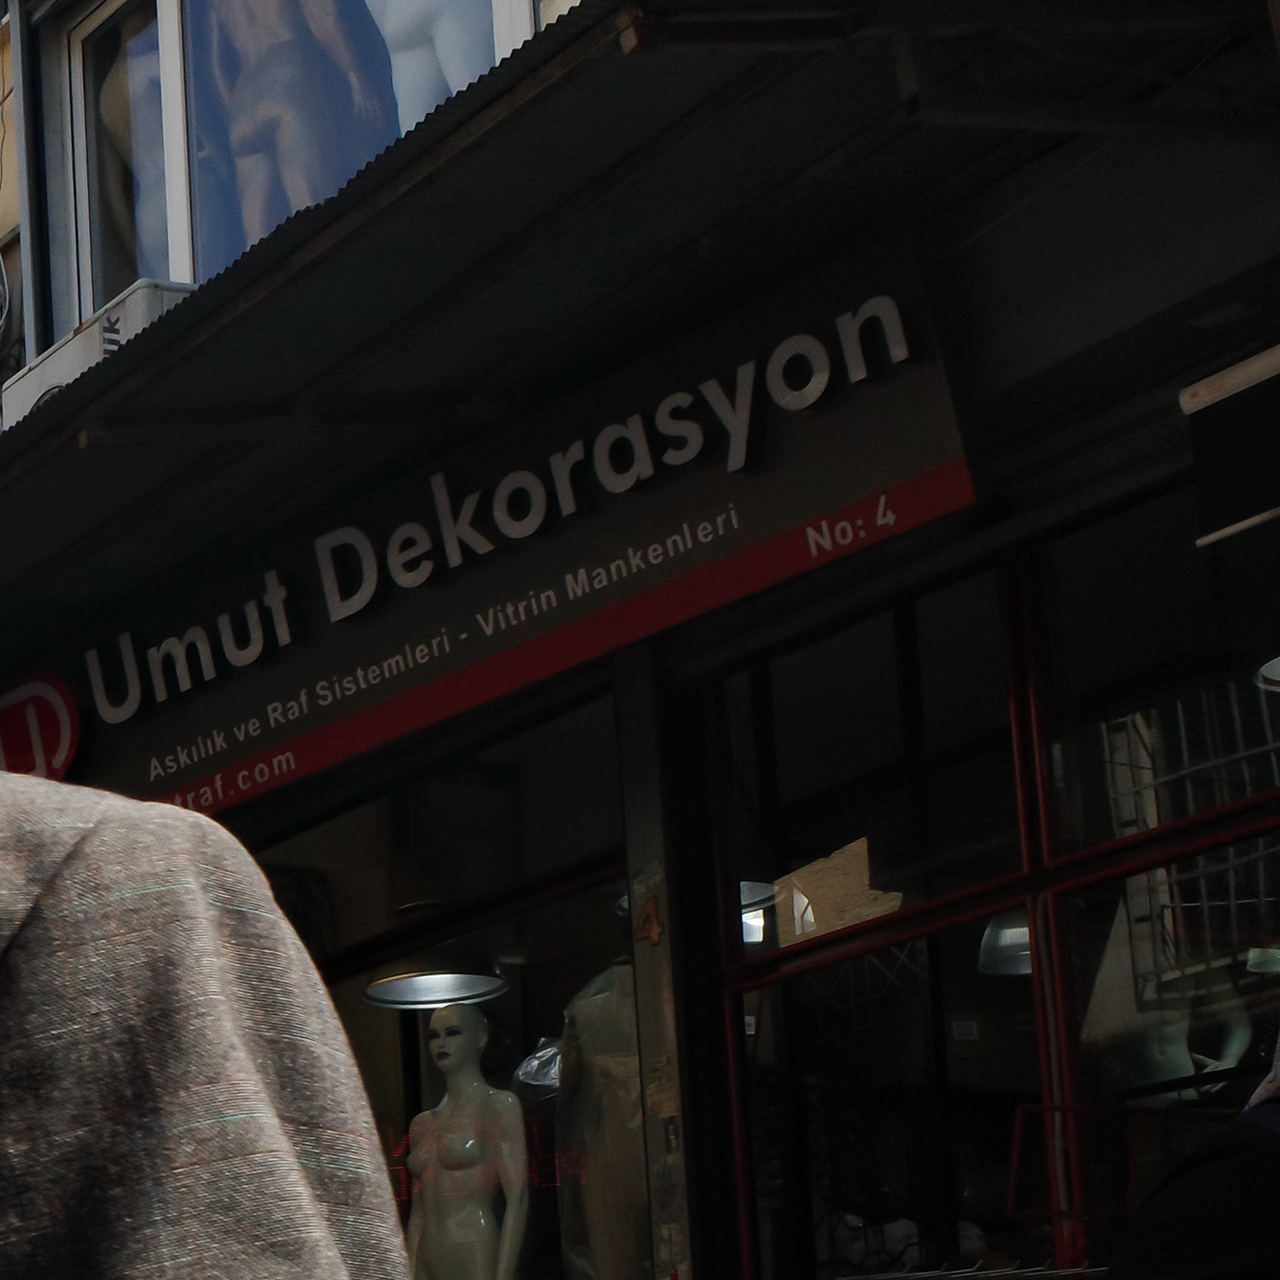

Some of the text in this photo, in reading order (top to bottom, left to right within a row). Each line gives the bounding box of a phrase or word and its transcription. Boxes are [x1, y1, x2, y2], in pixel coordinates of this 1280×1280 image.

[85, 294, 910, 725] Umut Dekorasyon
[149, 729, 227, 781] Askılık
[233, 718, 261, 742] ve
[266, 688, 309, 728] Raf
[315, 628, 451, 706] Sistemleri
[476, 589, 558, 638] Vitrin
[564, 503, 740, 601] Mankenleri
[805, 494, 897, 559] No: 4
